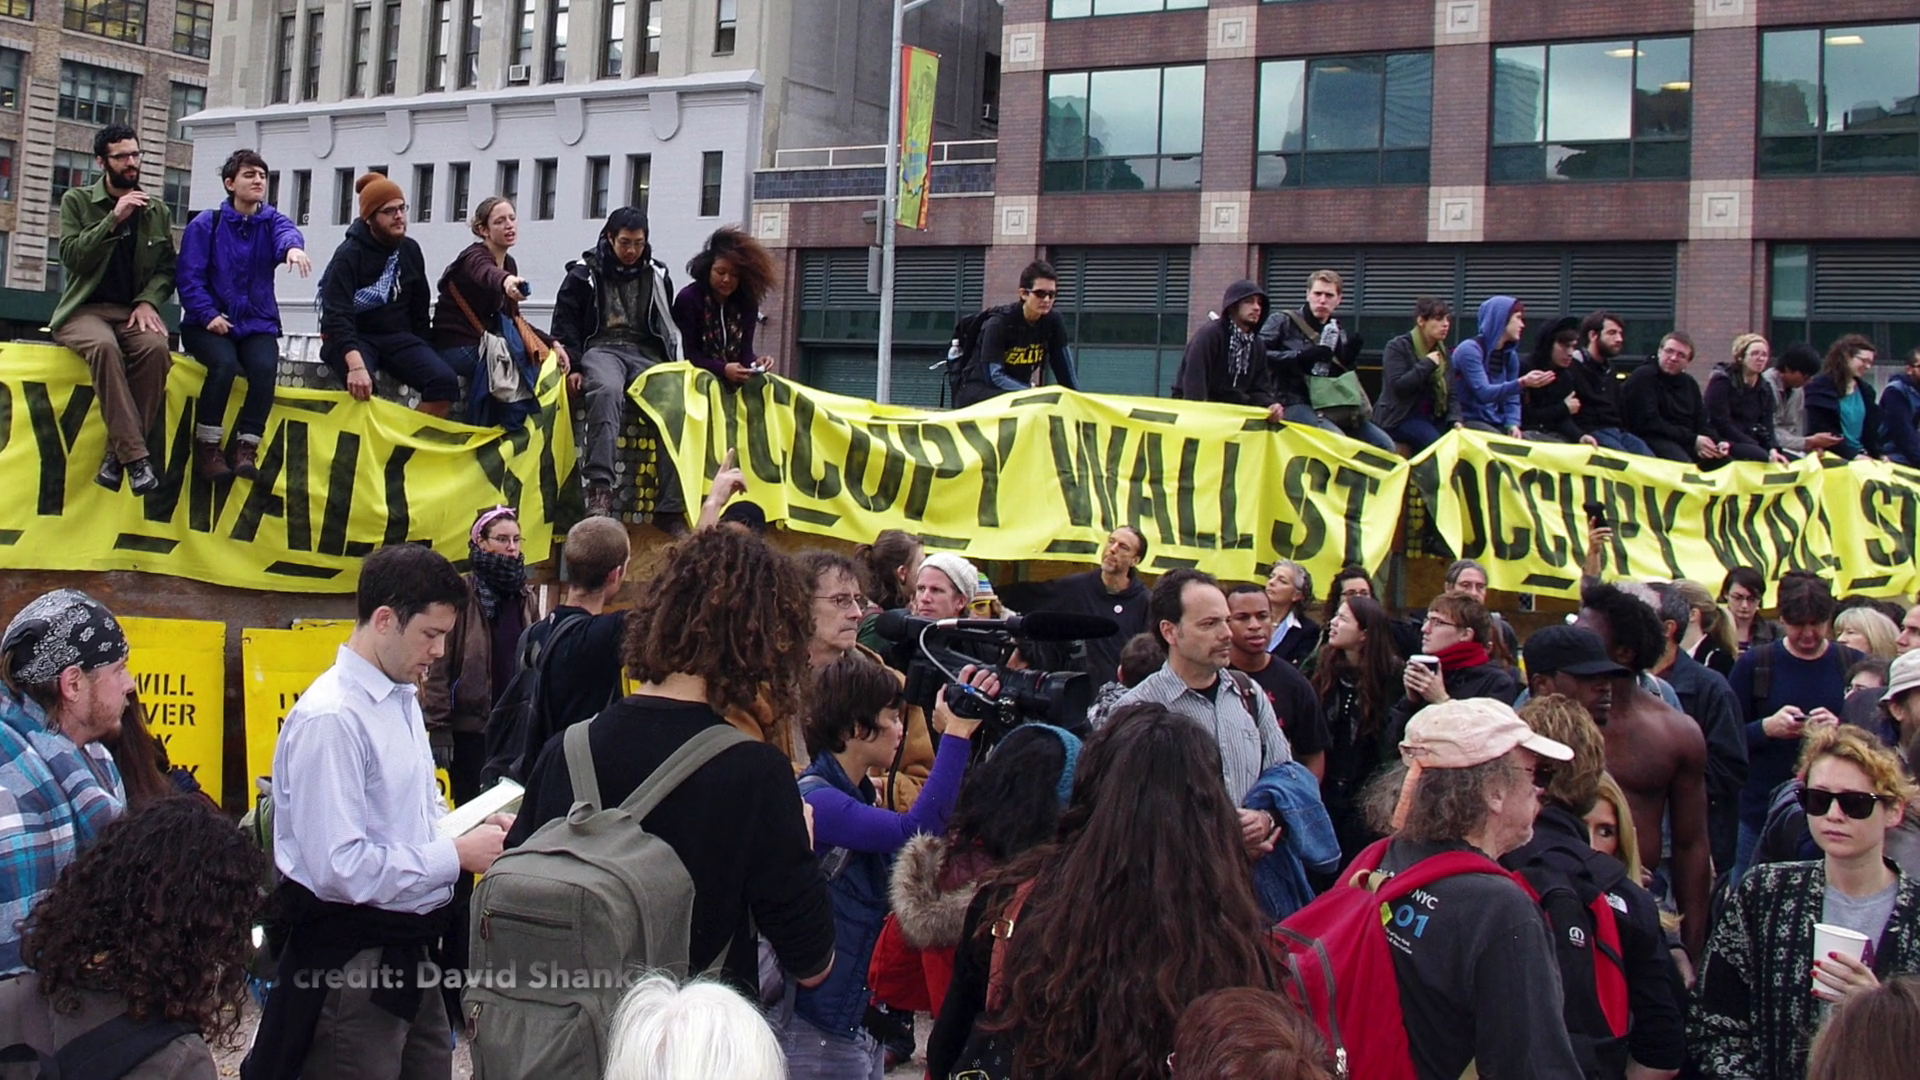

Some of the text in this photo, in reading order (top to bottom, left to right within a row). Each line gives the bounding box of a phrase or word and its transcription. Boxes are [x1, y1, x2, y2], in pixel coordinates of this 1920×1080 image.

[0, 381, 96, 516] Y
[695, 369, 1381, 568] OCCUPY WALL ST
[1451, 458, 1687, 579] OCCUPY
[140, 703, 196, 726] VER
[1394, 904, 1429, 938] 01
[1411, 889, 1439, 910] NYC
